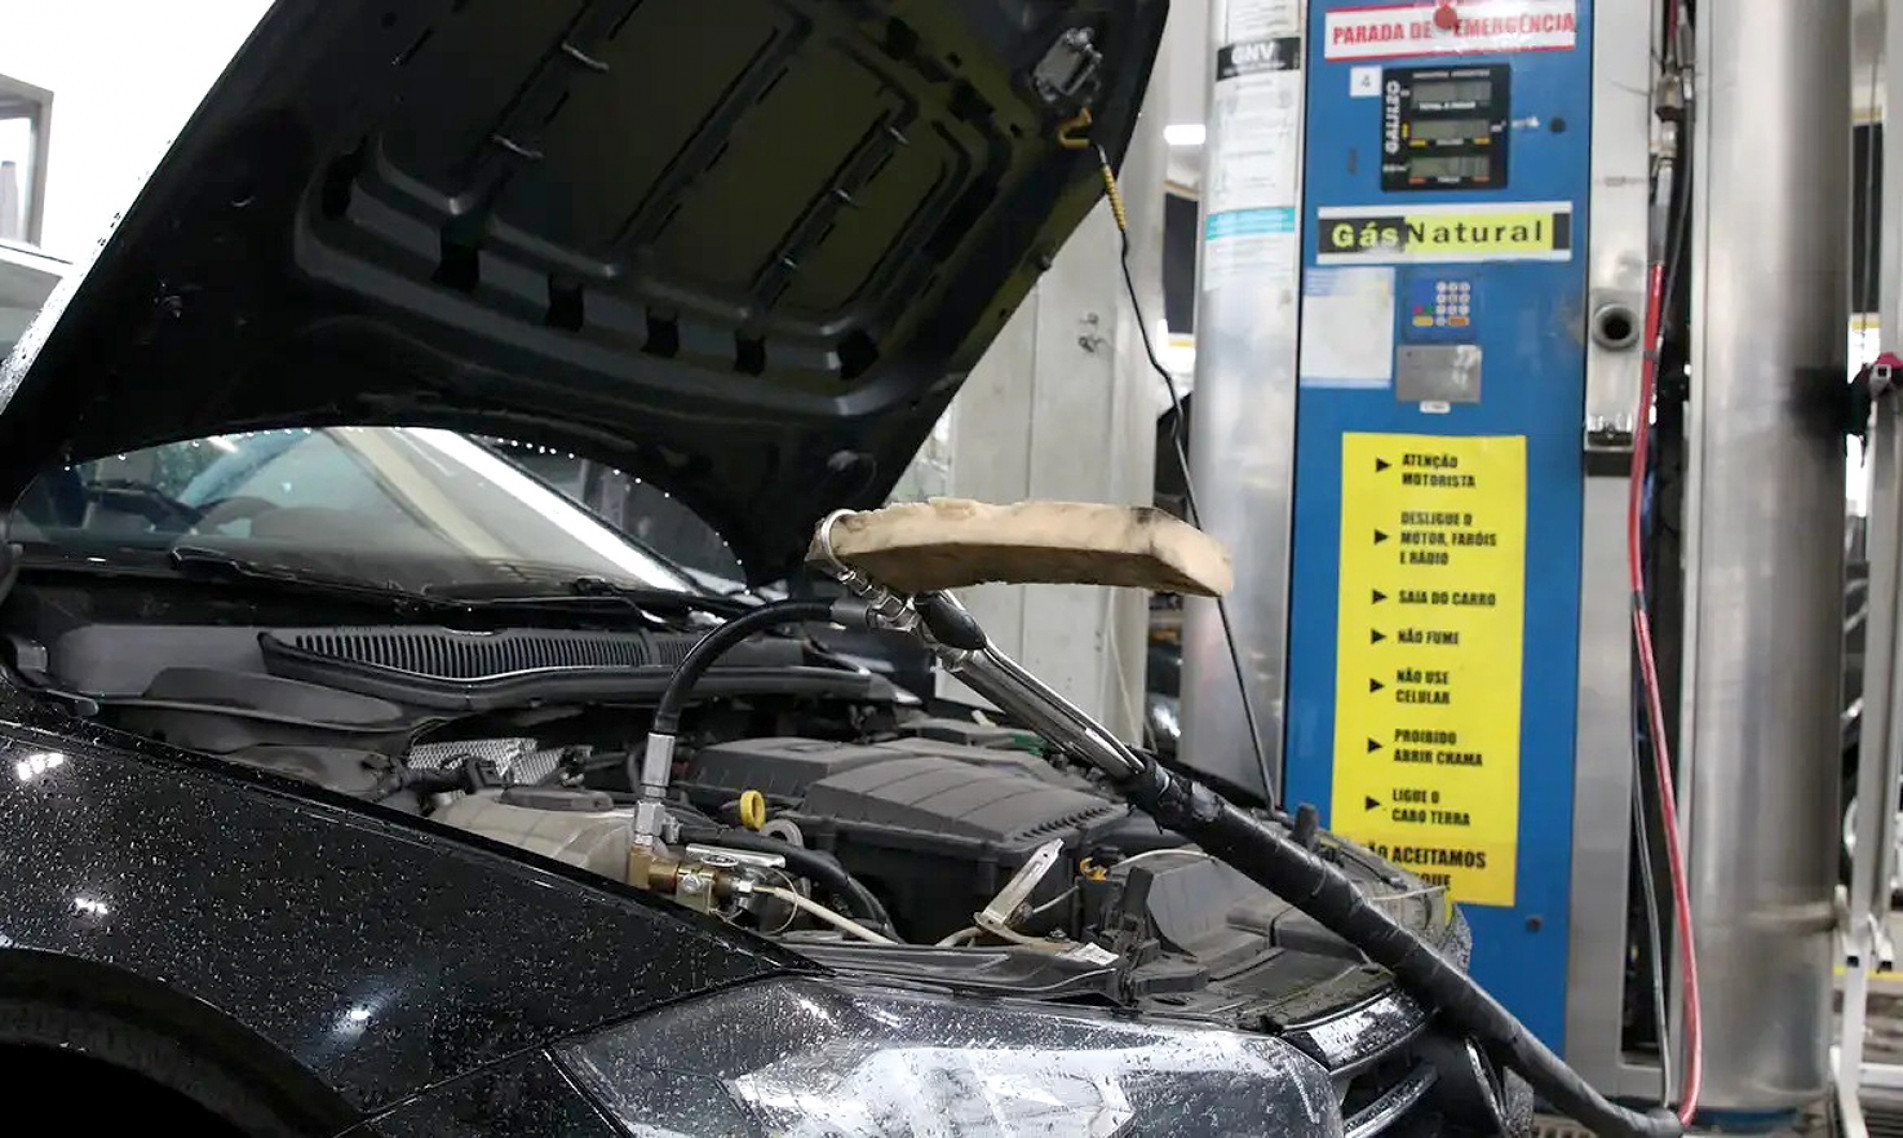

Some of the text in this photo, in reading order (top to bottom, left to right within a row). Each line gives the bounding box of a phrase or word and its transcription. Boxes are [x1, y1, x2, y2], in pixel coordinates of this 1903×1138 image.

[1333, 22, 1404, 44] PARADA
[1410, 21, 1432, 39] DE
[1331, 219, 1543, 248] Gás Natural
[1402, 453, 1458, 470] ATENÇÃO
[1402, 472, 1476, 488] MOTORISTA
[1401, 511, 1473, 527] DESLIGUE O
[1401, 530, 1497, 547] MOTOR, FARÓIS
[1400, 549, 1449, 566] E RÁDIO
[1399, 590, 1496, 606] SAIA DO CARRO
[1398, 628, 1459, 645] NÃO FUME
[1396, 667, 1449, 685] NÃO USE
[1396, 689, 1450, 705] CELULAR
[1394, 728, 1457, 745] PROIBIDO
[1393, 749, 1483, 767] ABRIR CHAMA
[1392, 788, 1440, 804] LIGUE O
[1391, 808, 1470, 826] CABO TERRA
[1392, 845, 1487, 868] ACEITAMOS
